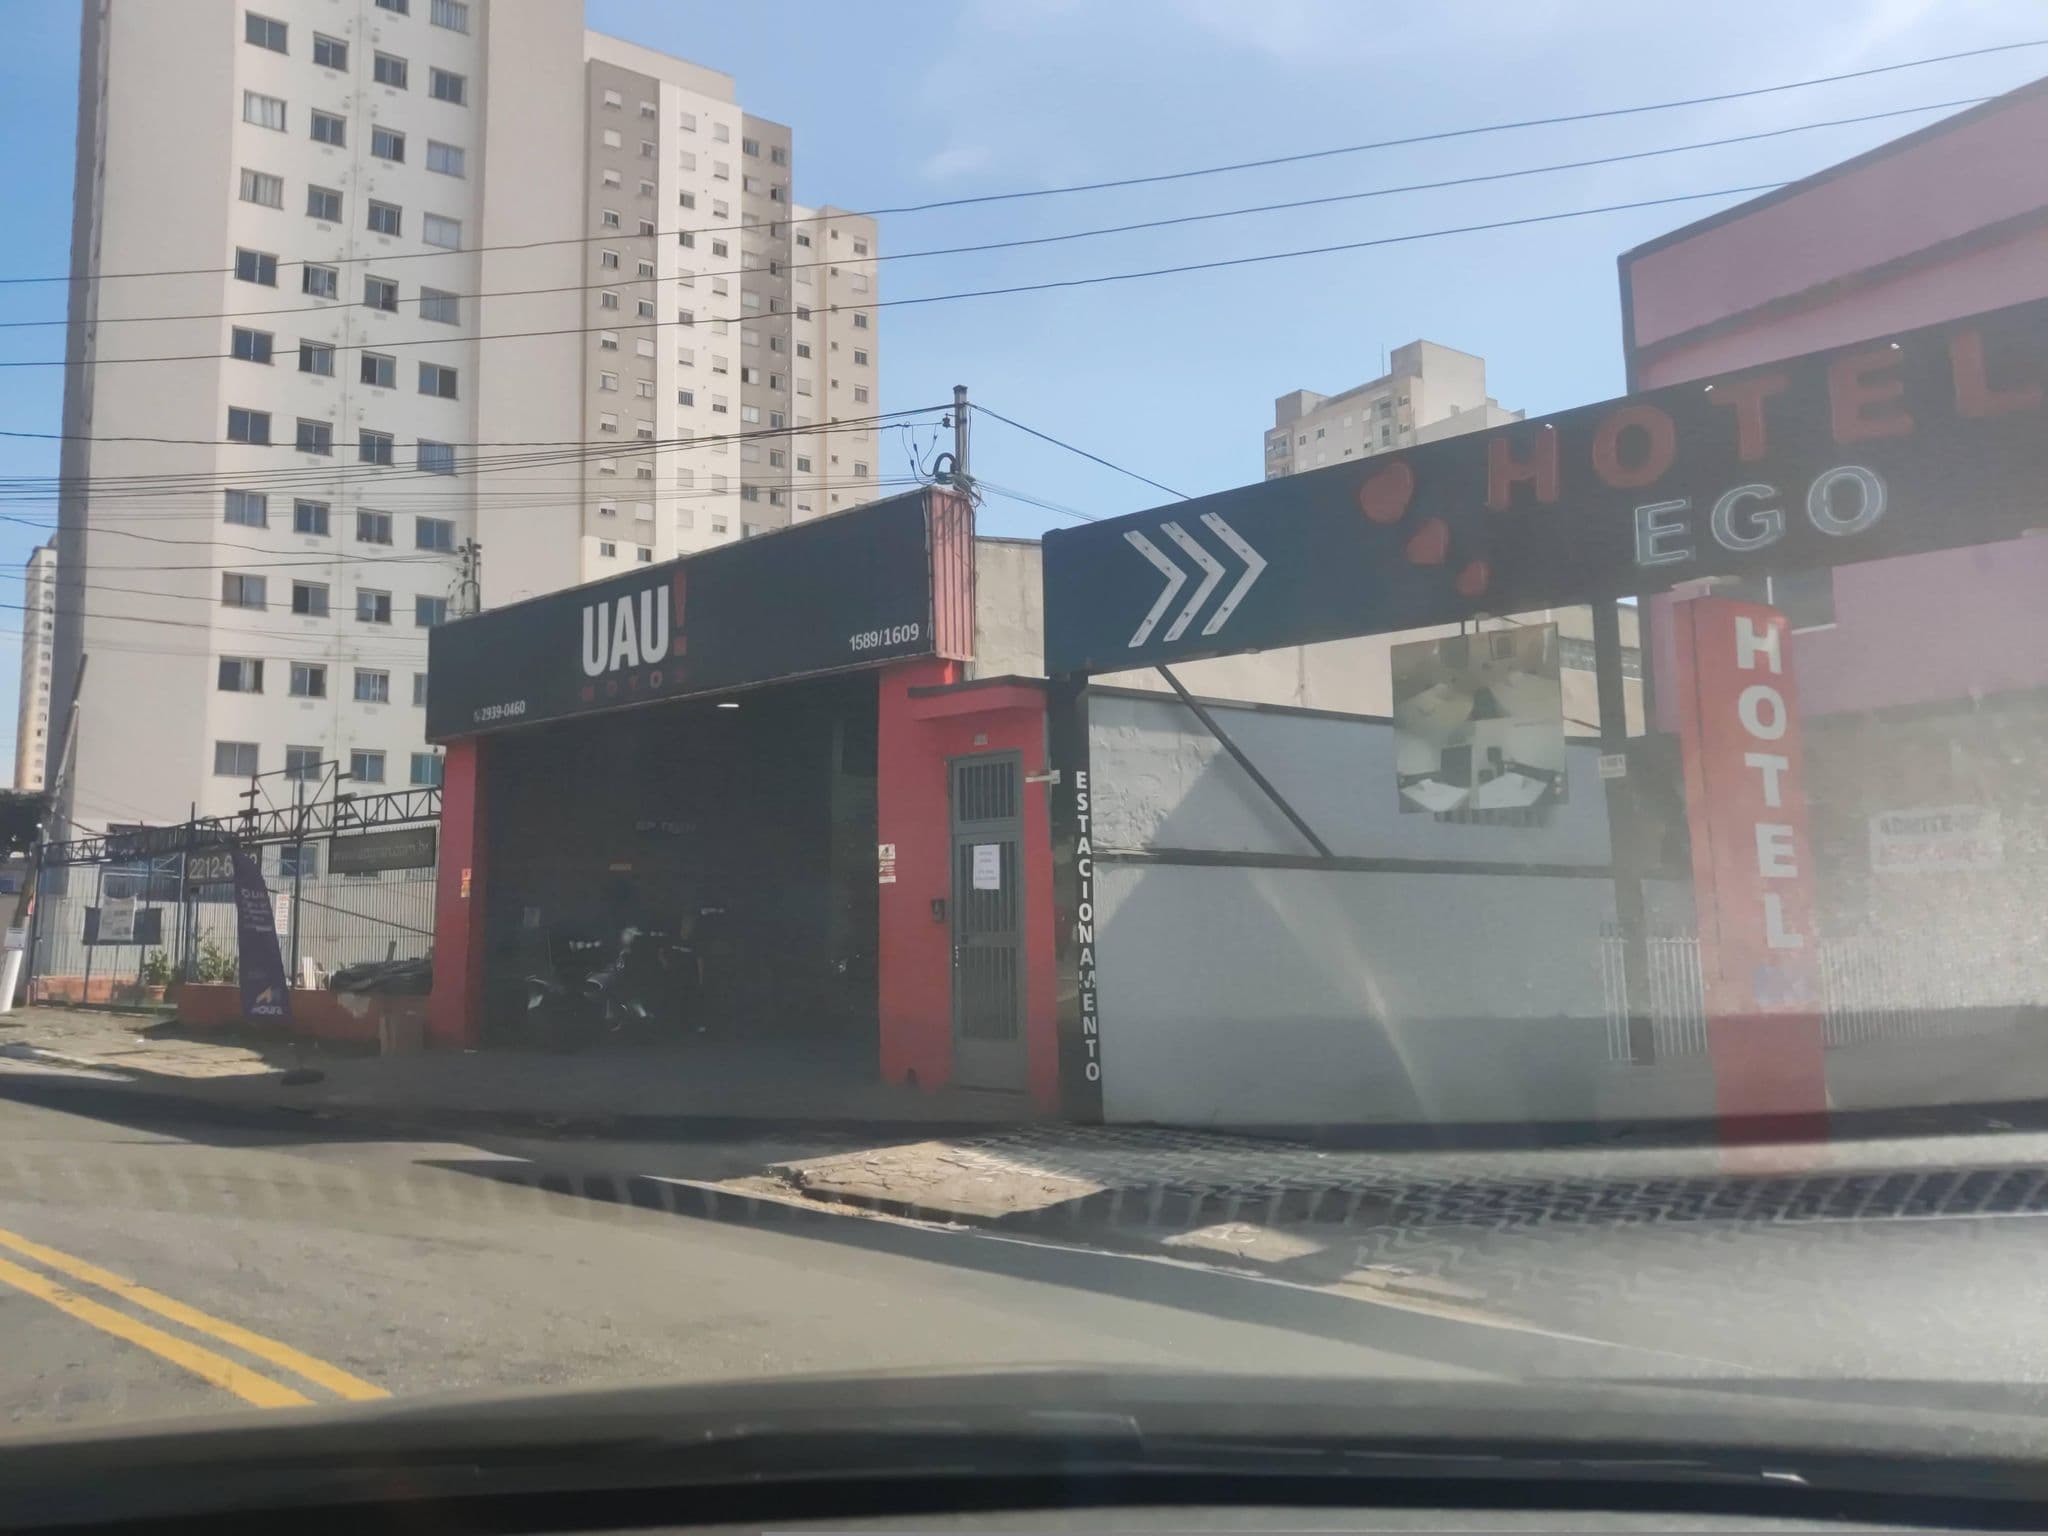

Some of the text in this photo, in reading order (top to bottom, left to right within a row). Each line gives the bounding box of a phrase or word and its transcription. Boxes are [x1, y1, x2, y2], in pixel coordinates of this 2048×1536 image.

[1486, 330, 2043, 513] HOTEL
[1633, 465, 1888, 567] EGO
[849, 622, 919, 652] 1589/1609
[481, 700, 526, 721] 2939-0460
[1735, 616, 1803, 949] HOTEL
[1076, 771, 1100, 1081] ESTACIONAMENTO
